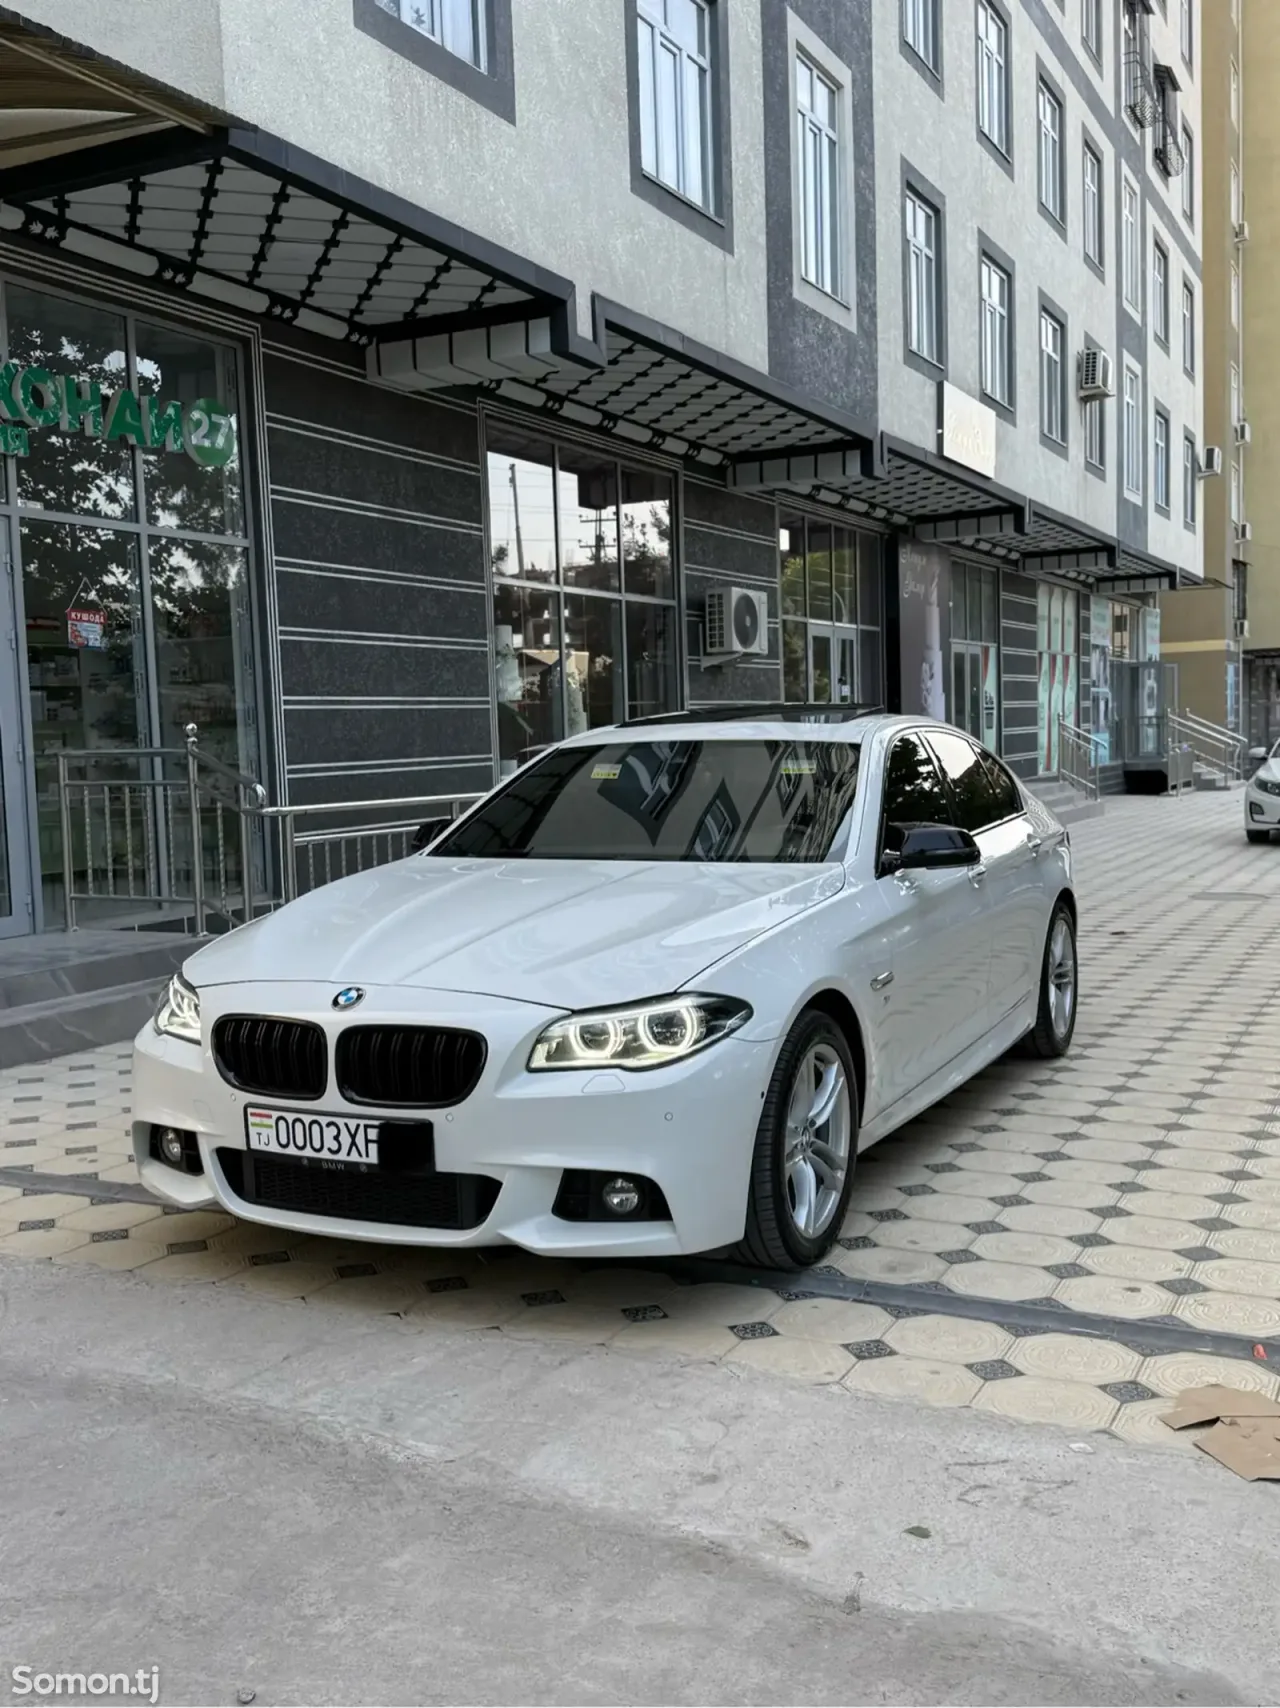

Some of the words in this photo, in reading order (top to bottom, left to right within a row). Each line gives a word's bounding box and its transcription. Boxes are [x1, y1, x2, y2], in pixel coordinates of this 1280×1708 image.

[191, 410, 230, 449] 27
[71, 611, 105, 623] КУШОДА
[256, 1132, 271, 1147] TJ
[321, 1160, 345, 1170] BMW
